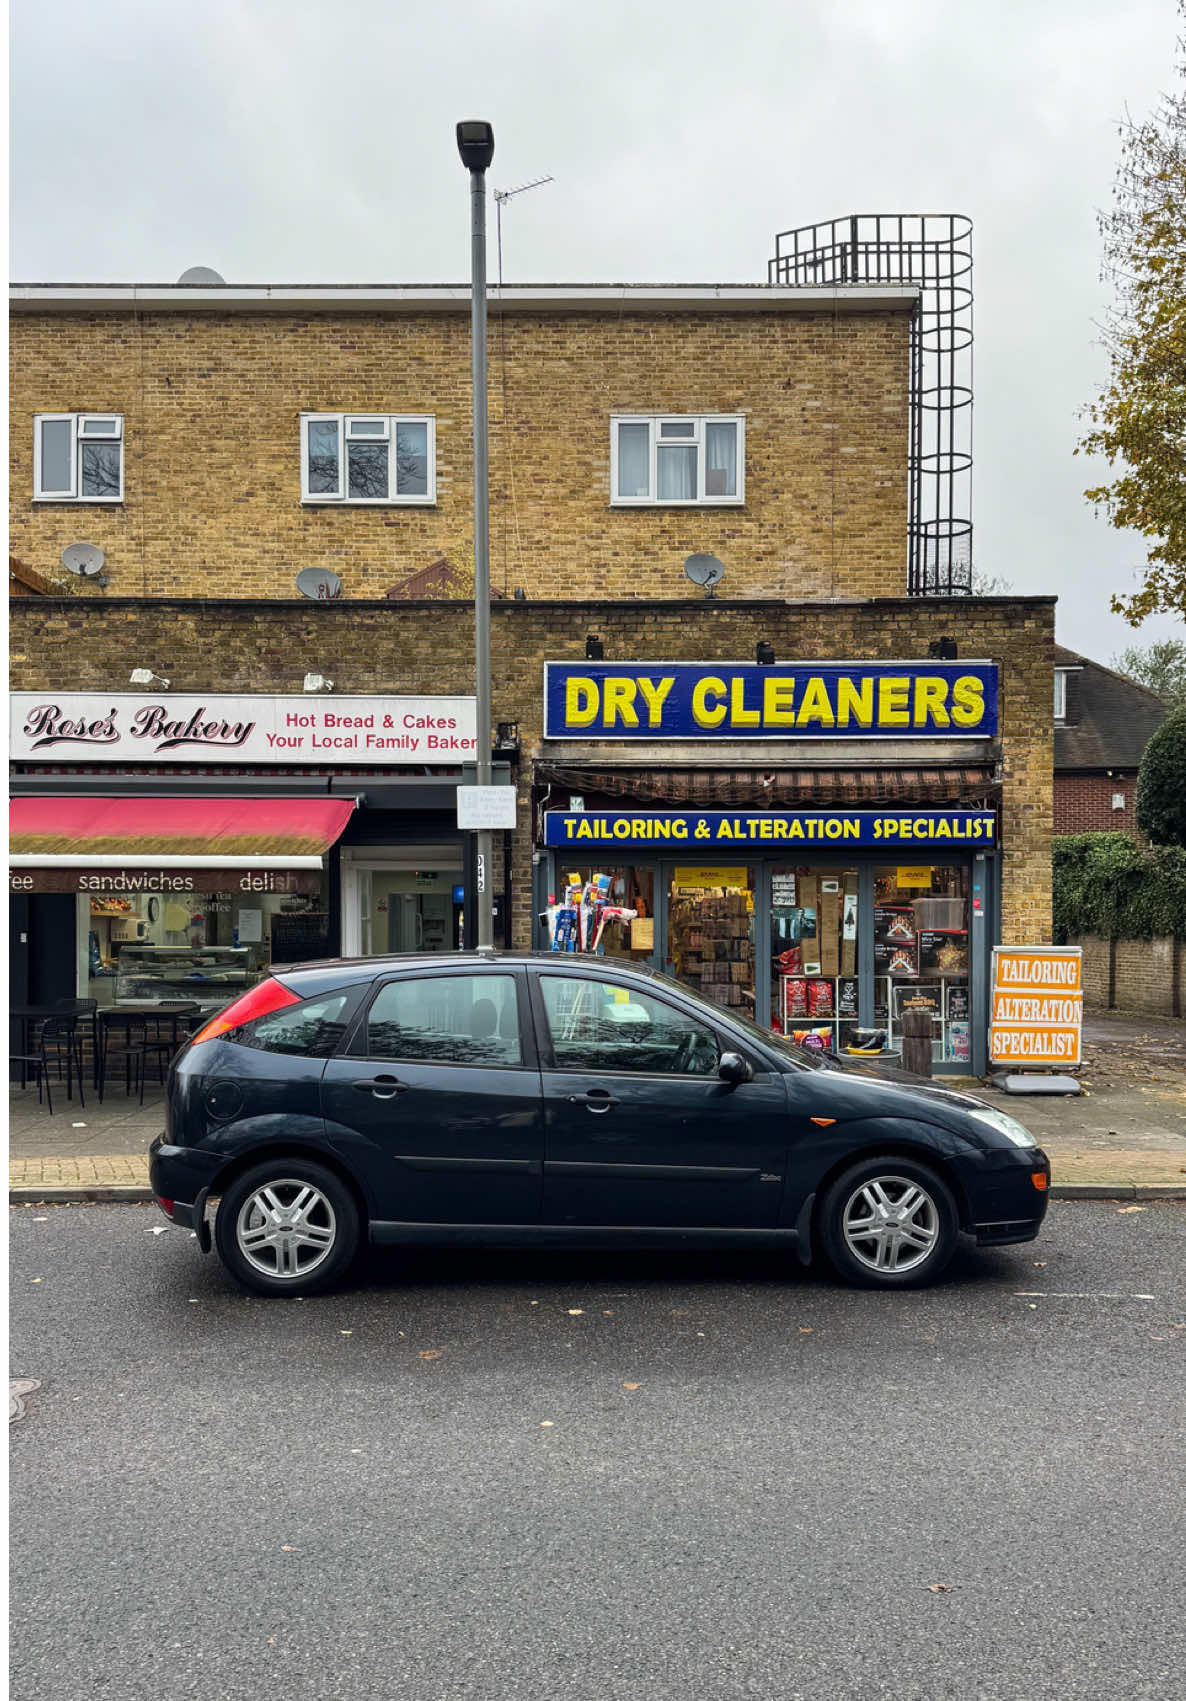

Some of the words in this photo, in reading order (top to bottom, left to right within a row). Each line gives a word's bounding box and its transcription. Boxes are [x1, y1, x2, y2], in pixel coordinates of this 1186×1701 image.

[565, 677, 675, 728] DRY
[692, 676, 985, 728] CLEANERS
[23, 704, 121, 751] Rose's
[130, 705, 256, 753] Bakery
[286, 713, 316, 728] Hot
[324, 713, 374, 728] Bread
[382, 714, 394, 728] &
[403, 714, 456, 729] Cakes
[266, 733, 304, 748] Your
[312, 734, 358, 749] Local
[366, 734, 419, 751] Family
[427, 735, 478, 749] Baker
[564, 819, 688, 839] TAILORING
[694, 819, 711, 839] &
[716, 819, 860, 839] ALTERATION
[873, 818, 995, 839] SPECIALIST
[79, 871, 194, 890] sandwiches
[1001, 959, 1077, 985] TAILORING
[995, 998, 1081, 1023] ALTERATION
[993, 1031, 1074, 1056] SPECIALIST
